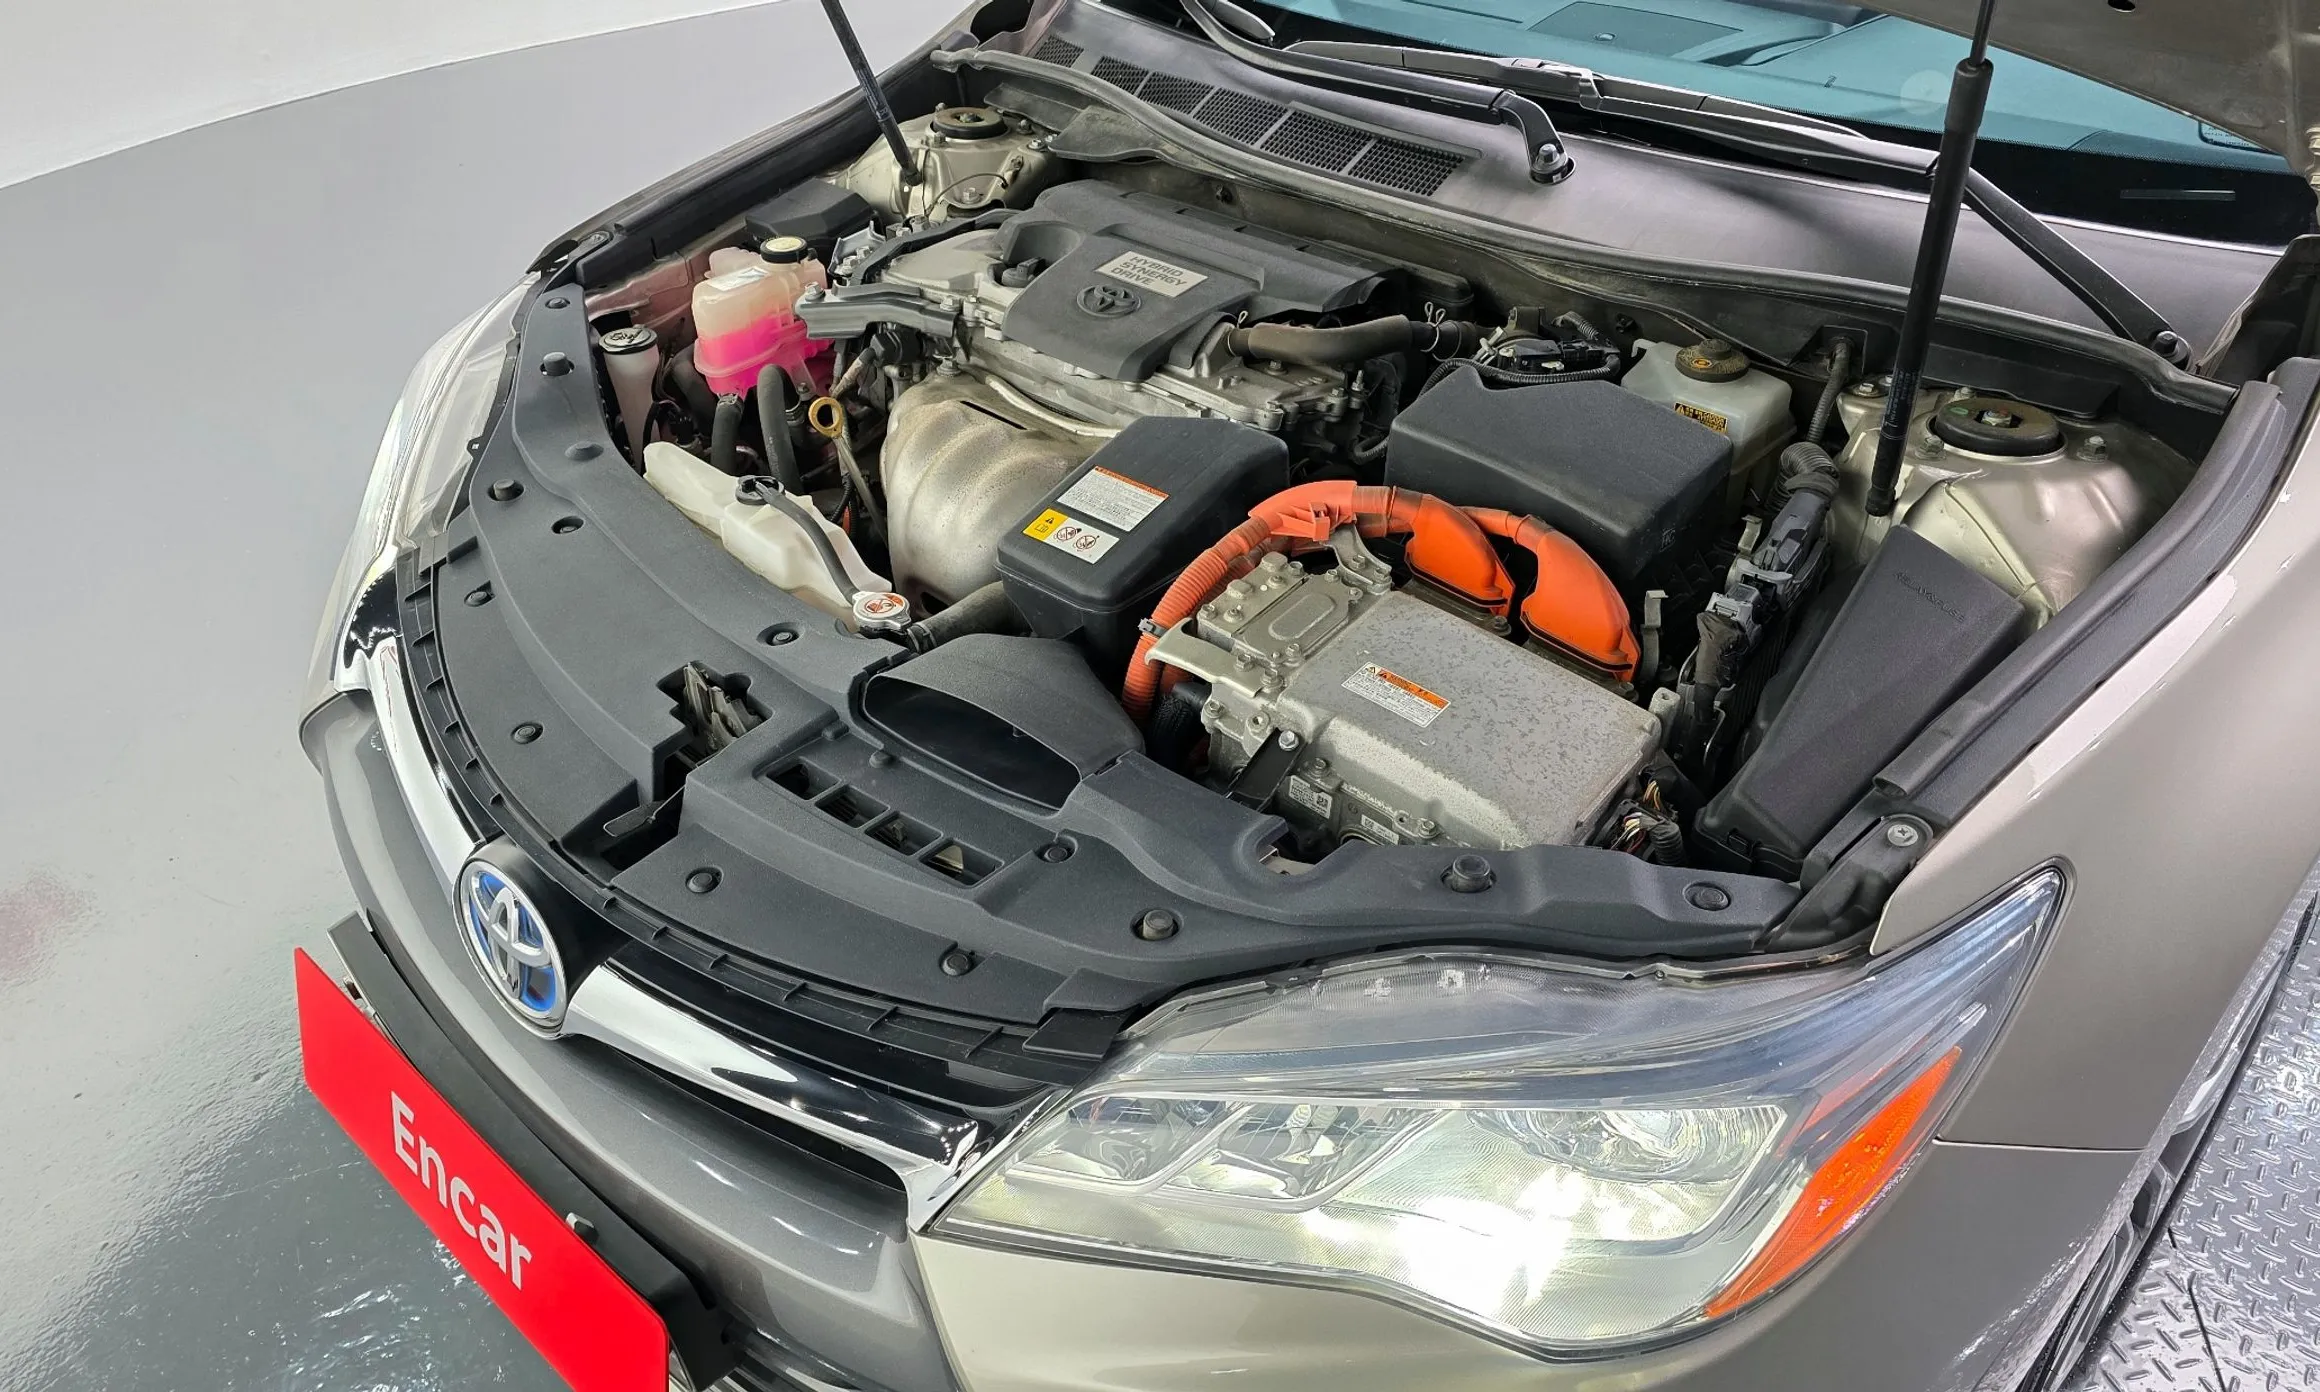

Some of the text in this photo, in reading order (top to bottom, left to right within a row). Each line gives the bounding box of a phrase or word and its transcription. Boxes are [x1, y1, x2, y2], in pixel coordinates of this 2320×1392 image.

[1111, 268, 1156, 285] DRIVE
[1119, 262, 1187, 286] SYNERGY
[1129, 256, 1184, 277] HYBRID
[391, 1090, 533, 1290] Encar
